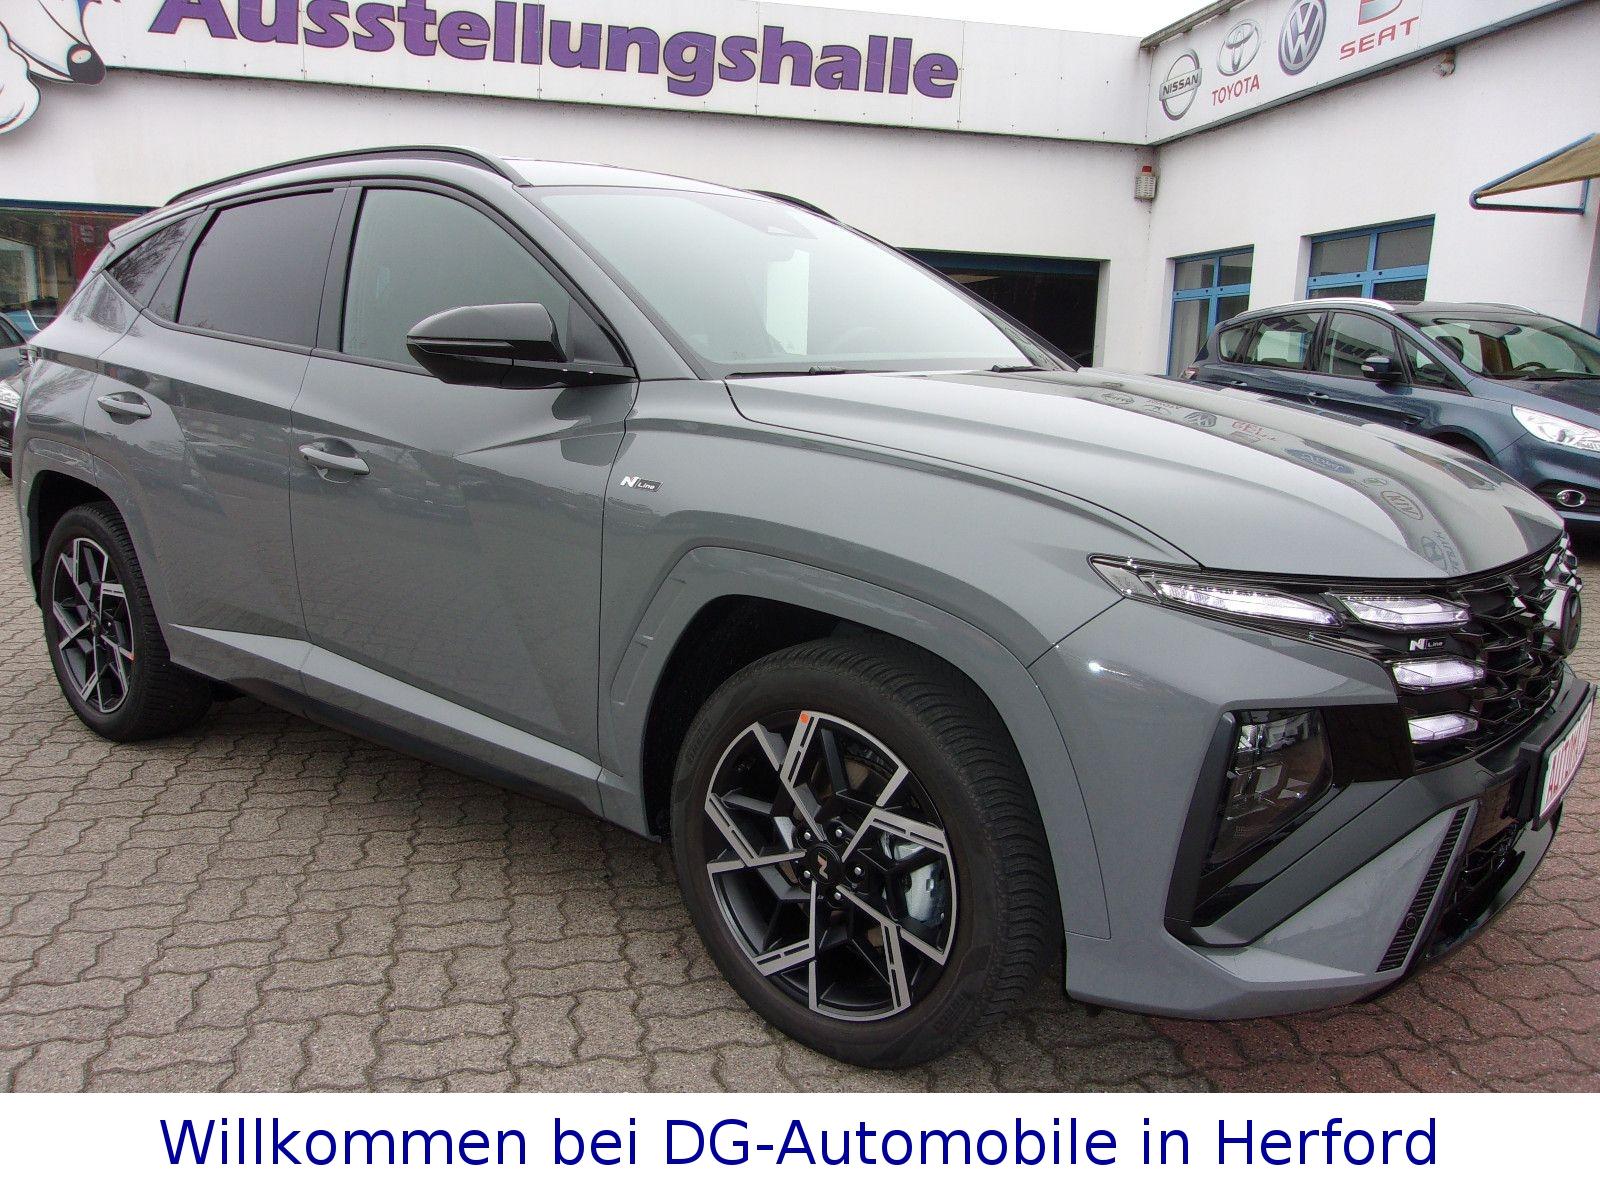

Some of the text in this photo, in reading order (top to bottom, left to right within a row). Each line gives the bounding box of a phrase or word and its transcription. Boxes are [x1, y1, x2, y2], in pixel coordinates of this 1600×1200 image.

[148, 0, 957, 98] Ausstellungshalle
[1339, 16, 1420, 61] SEAT
[1162, 73, 1200, 96] NISSAN
[1211, 74, 1260, 106] TOYOTA
[637, 482, 656, 490] Line
